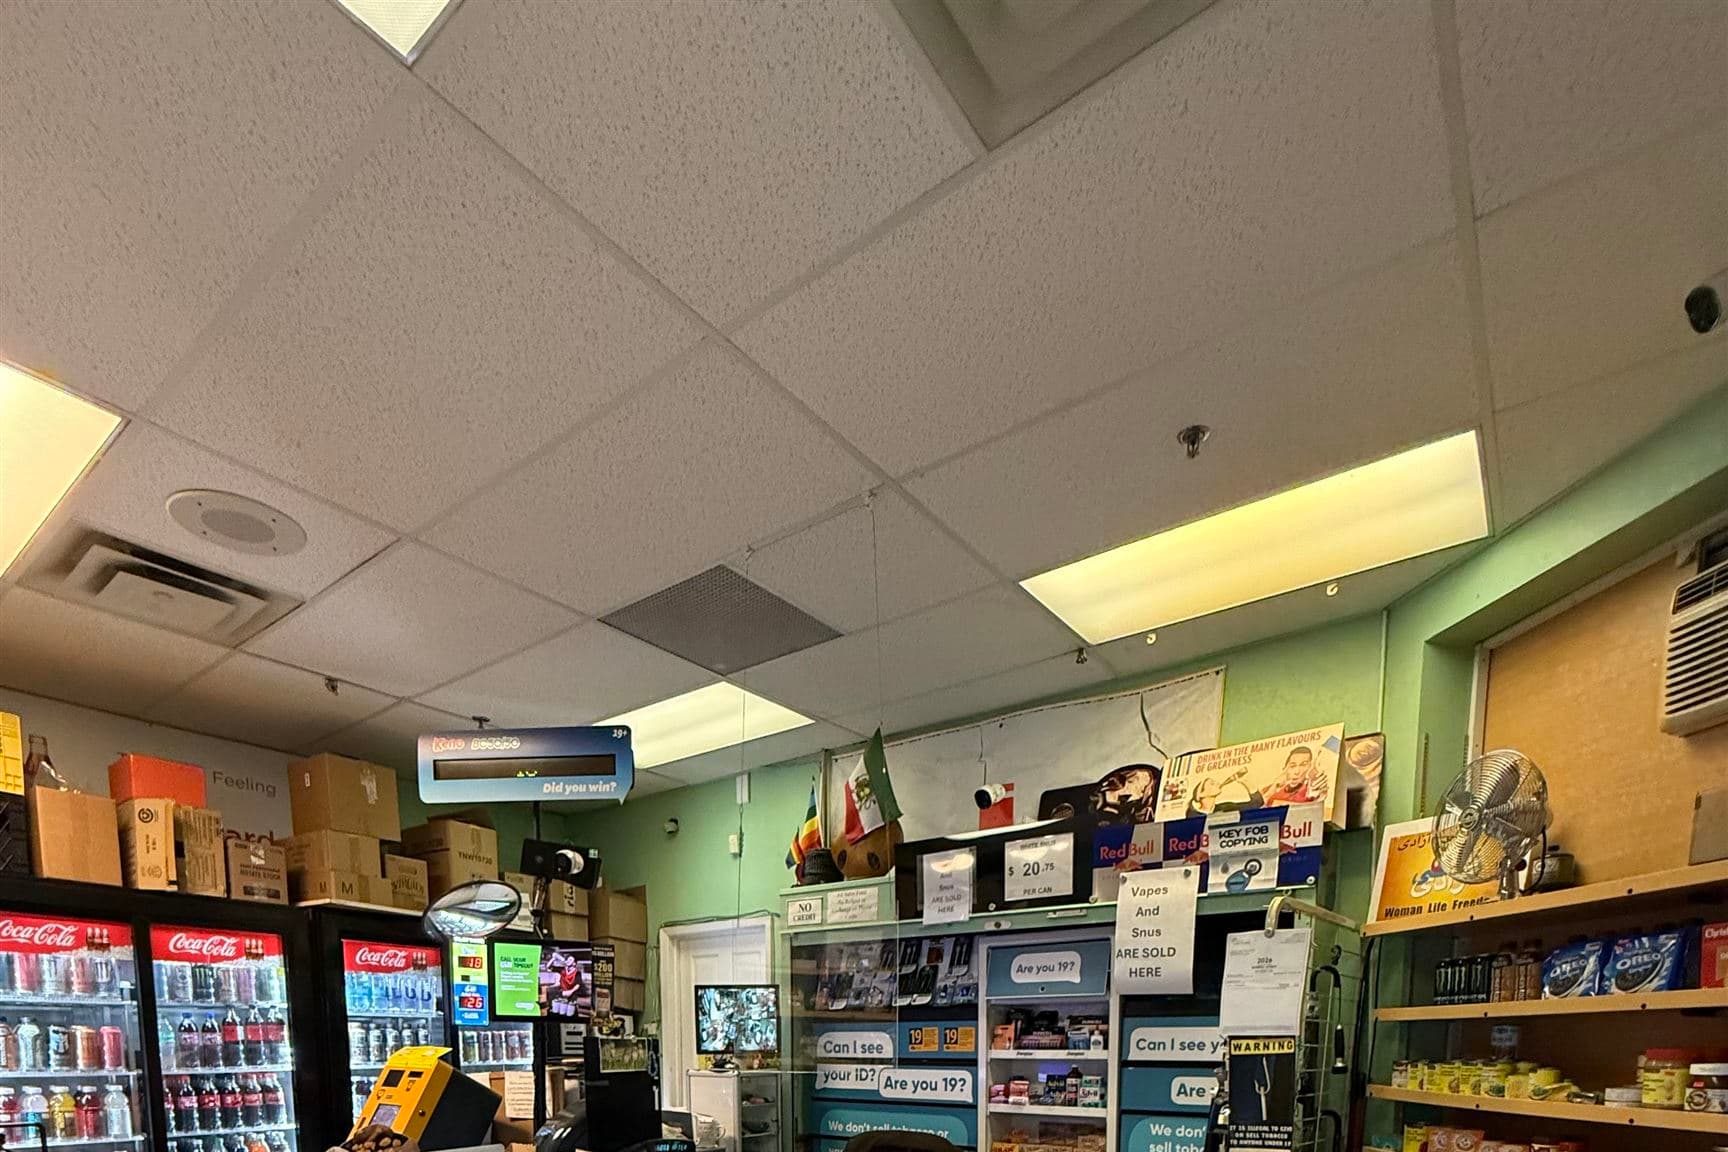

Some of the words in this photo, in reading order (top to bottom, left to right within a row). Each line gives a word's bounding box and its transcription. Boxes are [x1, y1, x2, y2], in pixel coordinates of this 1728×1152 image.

[1197, 752, 1223, 765] DRINK
[1223, 750, 1232, 759] IN
[1234, 747, 1249, 758] THE
[1251, 741, 1275, 753] MANY
[1276, 731, 1321, 747] FLAVOURS
[1196, 763, 1205, 774] OF
[1207, 754, 1252, 772] GREATNESS
[212, 769, 277, 797] Feeling
[543, 782, 562, 793] Did
[565, 784, 586, 795] you
[588, 782, 616, 793] win?
[1218, 828, 1242, 840] KEY
[1245, 826, 1269, 837] FOB
[1281, 821, 1312, 839] Bull
[1169, 835, 1197, 851] Red
[1220, 835, 1268, 848] COPYING
[1100, 844, 1126, 859] Red
[1129, 840, 1154, 856] Bull
[1008, 866, 1014, 877] $
[1038, 886, 1052, 894] CAN
[1131, 885, 1168, 897] Vapes
[798, 903, 812, 913] NO
[1136, 905, 1159, 917] And
[1384, 905, 1423, 917] Woman
[1428, 902, 1447, 913] Life
[793, 914, 815, 922] CREDIT
[0, 917, 79, 948] Coca-Cola
[1131, 927, 1161, 938] Snus
[168, 932, 240, 957] Coca-Cola
[355, 946, 407, 969] Coca-Cola
[1116, 948, 1139, 958] ARE
[1142, 947, 1176, 957] SOLD
[468, 957, 482, 969] 18
[1550, 958, 1588, 978] OREO
[1616, 952, 1661, 970] OREO
[1016, 963, 1034, 974] Are
[1036, 964, 1056, 976] you
[1057, 961, 1075, 973] 19?
[1129, 967, 1161, 978] HERE
[467, 996, 483, 1008] 26
[909, 1029, 922, 1044] 19
[944, 1029, 957, 1044] 19
[823, 1041, 852, 1054] Can
[861, 1043, 884, 1054] see
[1136, 1038, 1165, 1051] Can
[1179, 1041, 1206, 1051] see
[1232, 1040, 1293, 1052] WARNING
[823, 1070, 851, 1082] your
[855, 1068, 876, 1082] ID?
[884, 1076, 907, 1090] Are
[912, 1080, 938, 1094] you
[942, 1077, 967, 1092] 19?
[1176, 1083, 1206, 1098] Are
[828, 1120, 843, 1131] We
[845, 1121, 870, 1133] don't
[1150, 1124, 1172, 1137] We
[1175, 1125, 1207, 1138] don'
